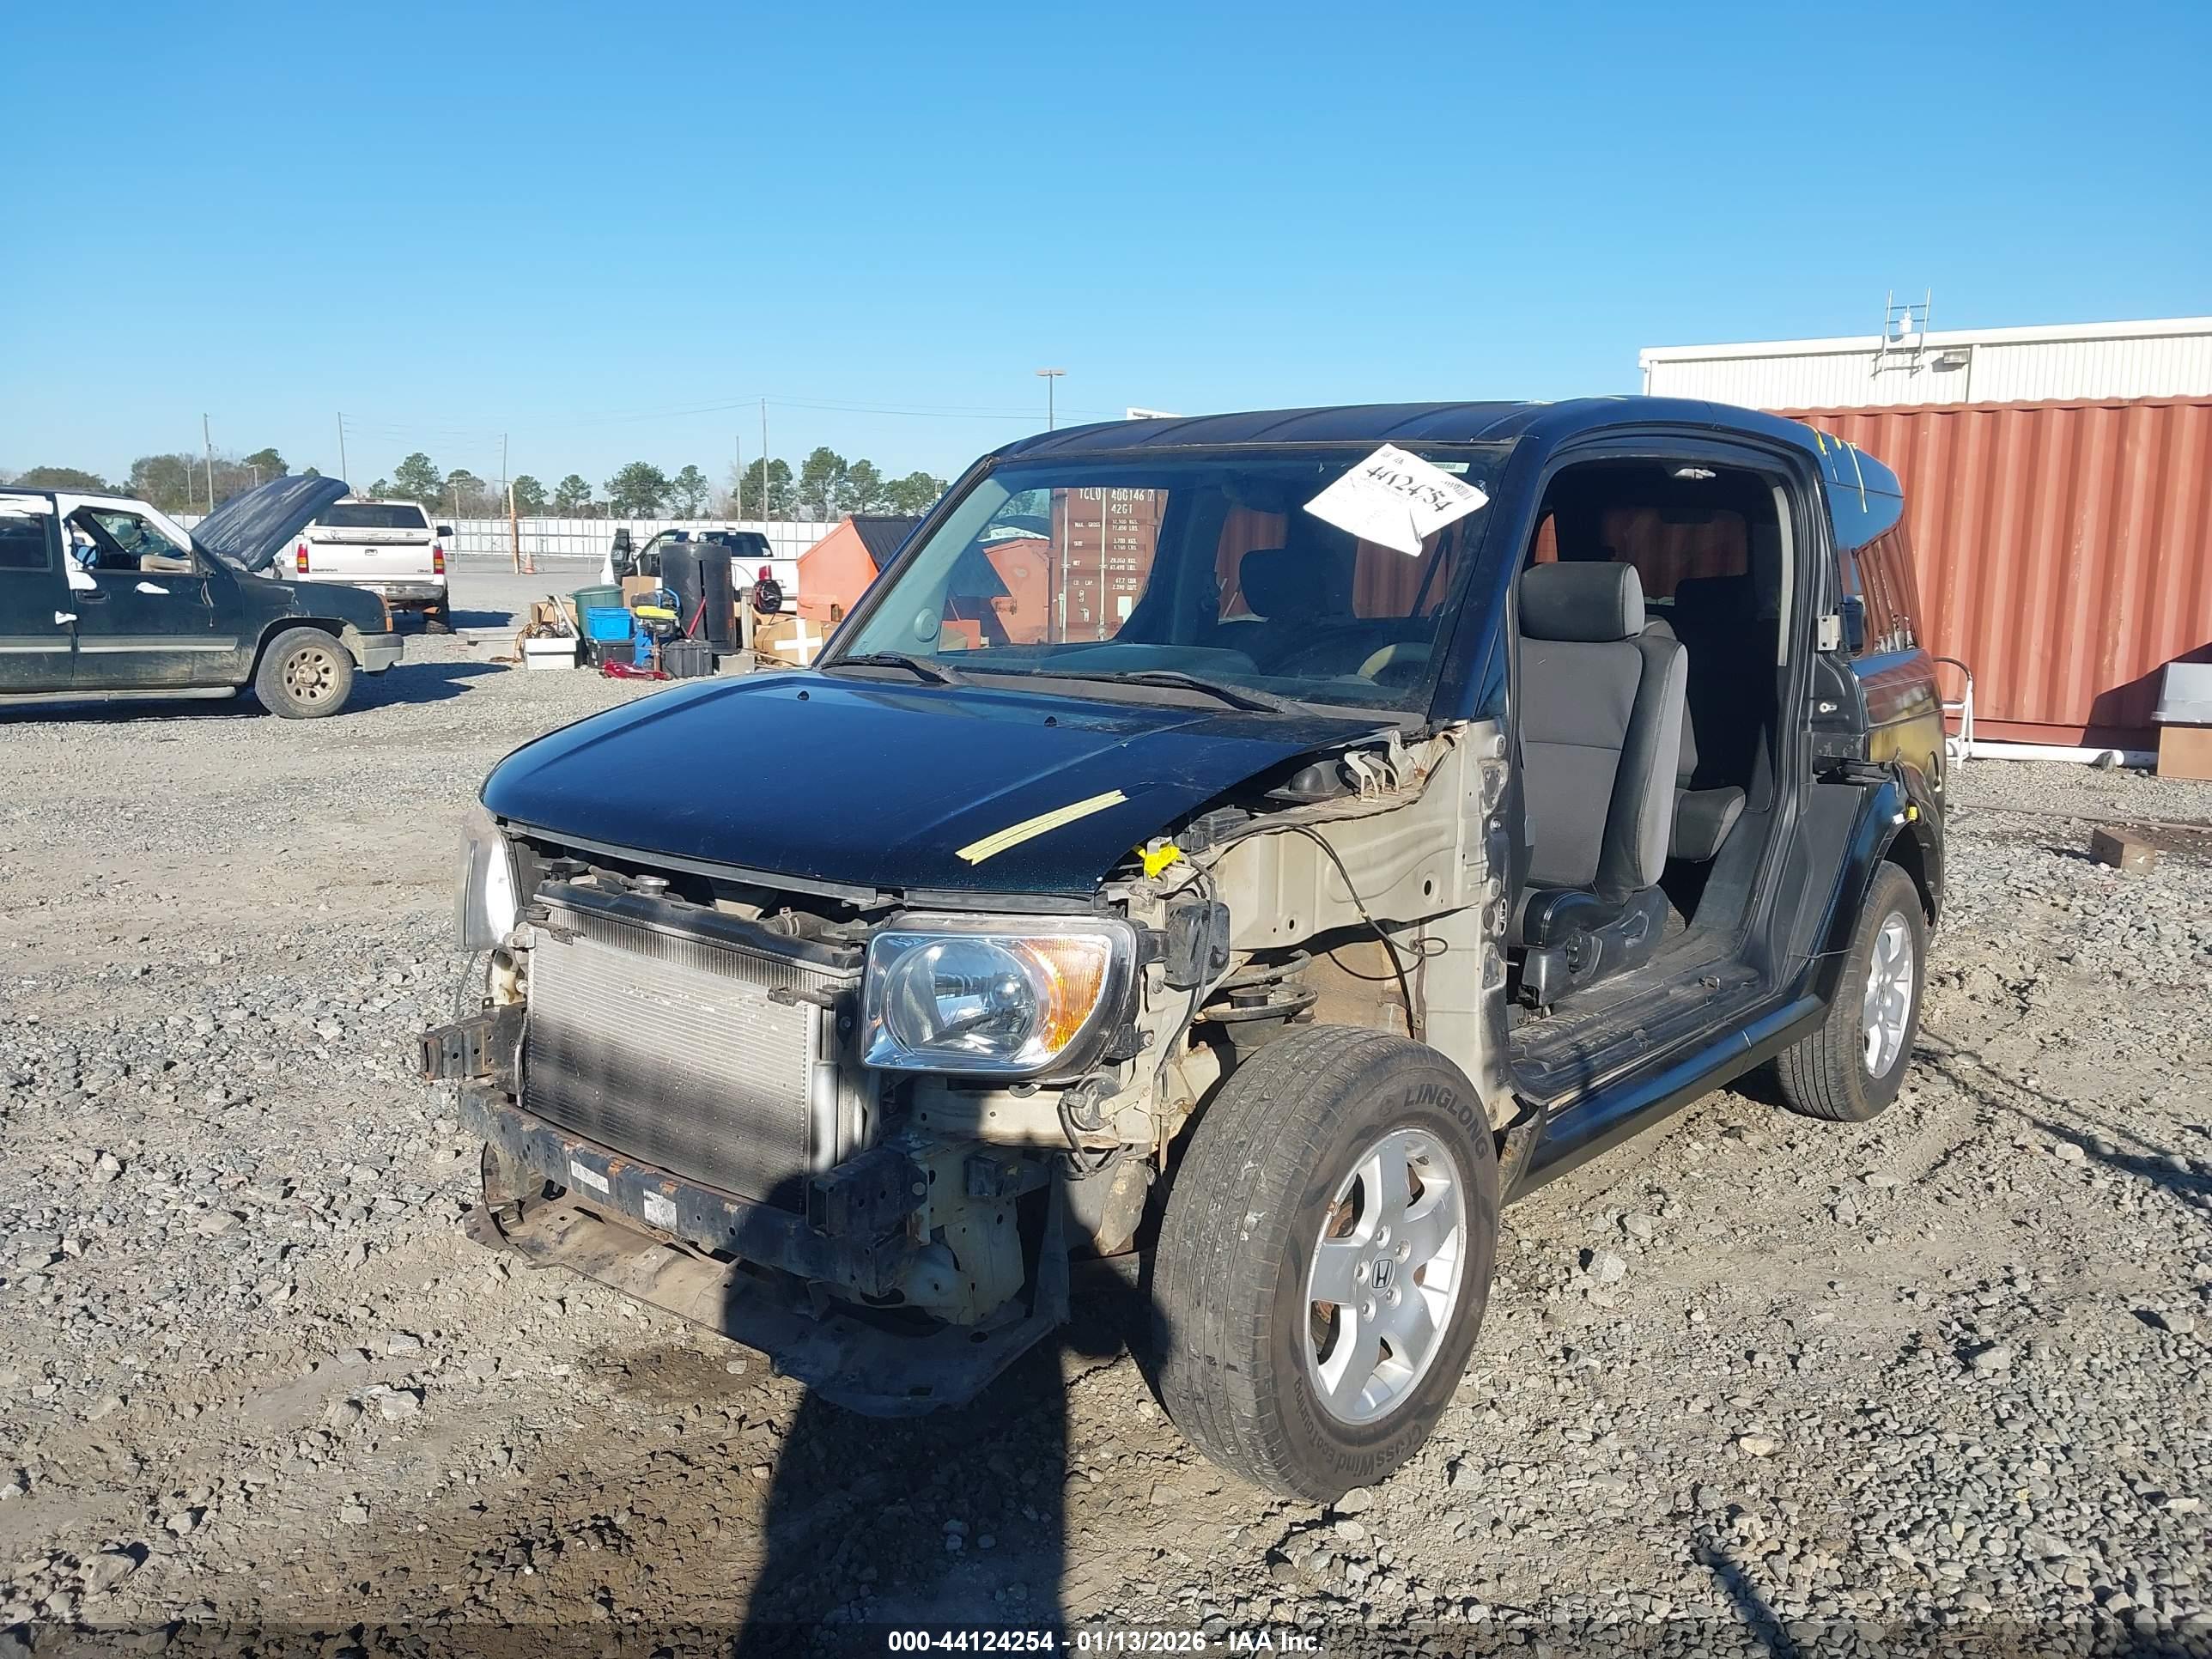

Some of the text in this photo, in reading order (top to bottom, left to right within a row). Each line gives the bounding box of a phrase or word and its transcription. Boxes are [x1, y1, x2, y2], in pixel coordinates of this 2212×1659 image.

[1111, 504, 1133, 514] 42G1
[1404, 1084, 1489, 1160] LINGLONG
[1334, 1424, 1424, 1478] CrossWind
